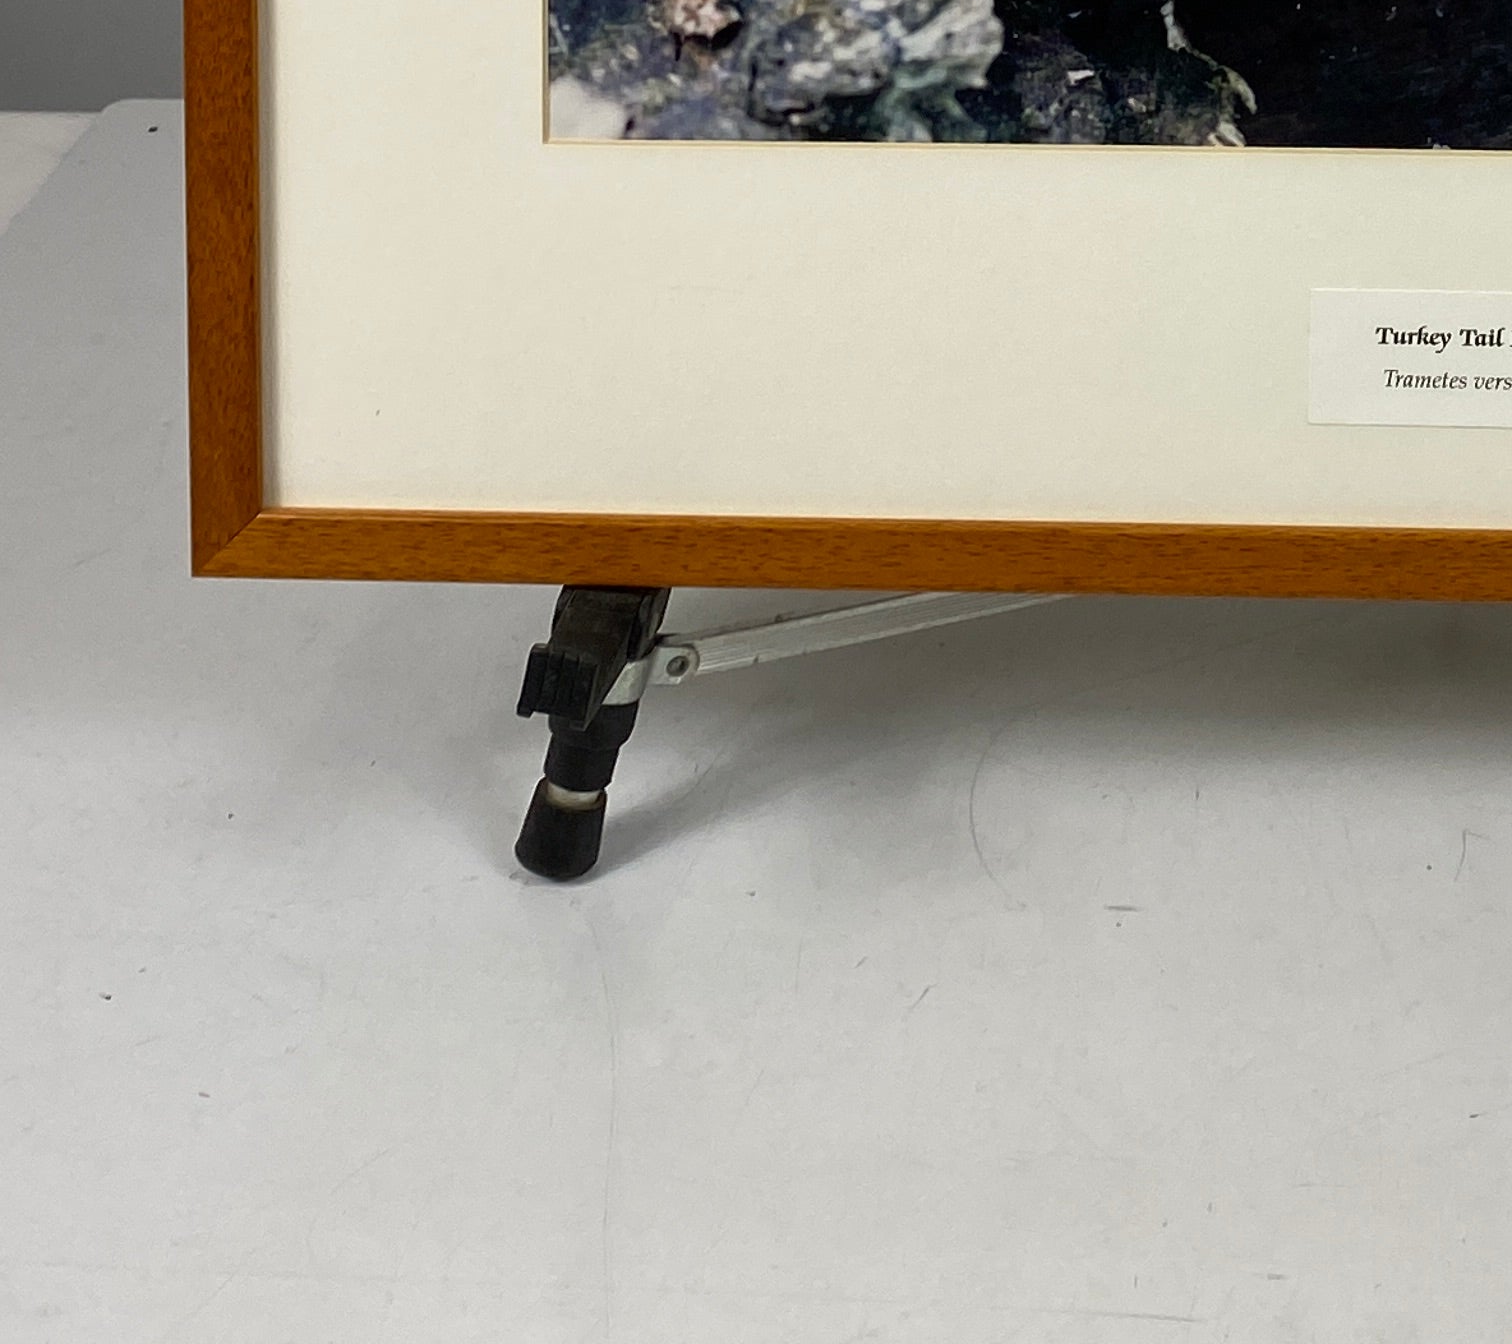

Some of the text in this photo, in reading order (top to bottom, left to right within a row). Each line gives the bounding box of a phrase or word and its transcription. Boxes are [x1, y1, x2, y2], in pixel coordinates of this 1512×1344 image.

[1375, 325, 1452, 354] Turkey
[1459, 327, 1506, 349] Tail
[1384, 369, 1468, 390] Trametes
